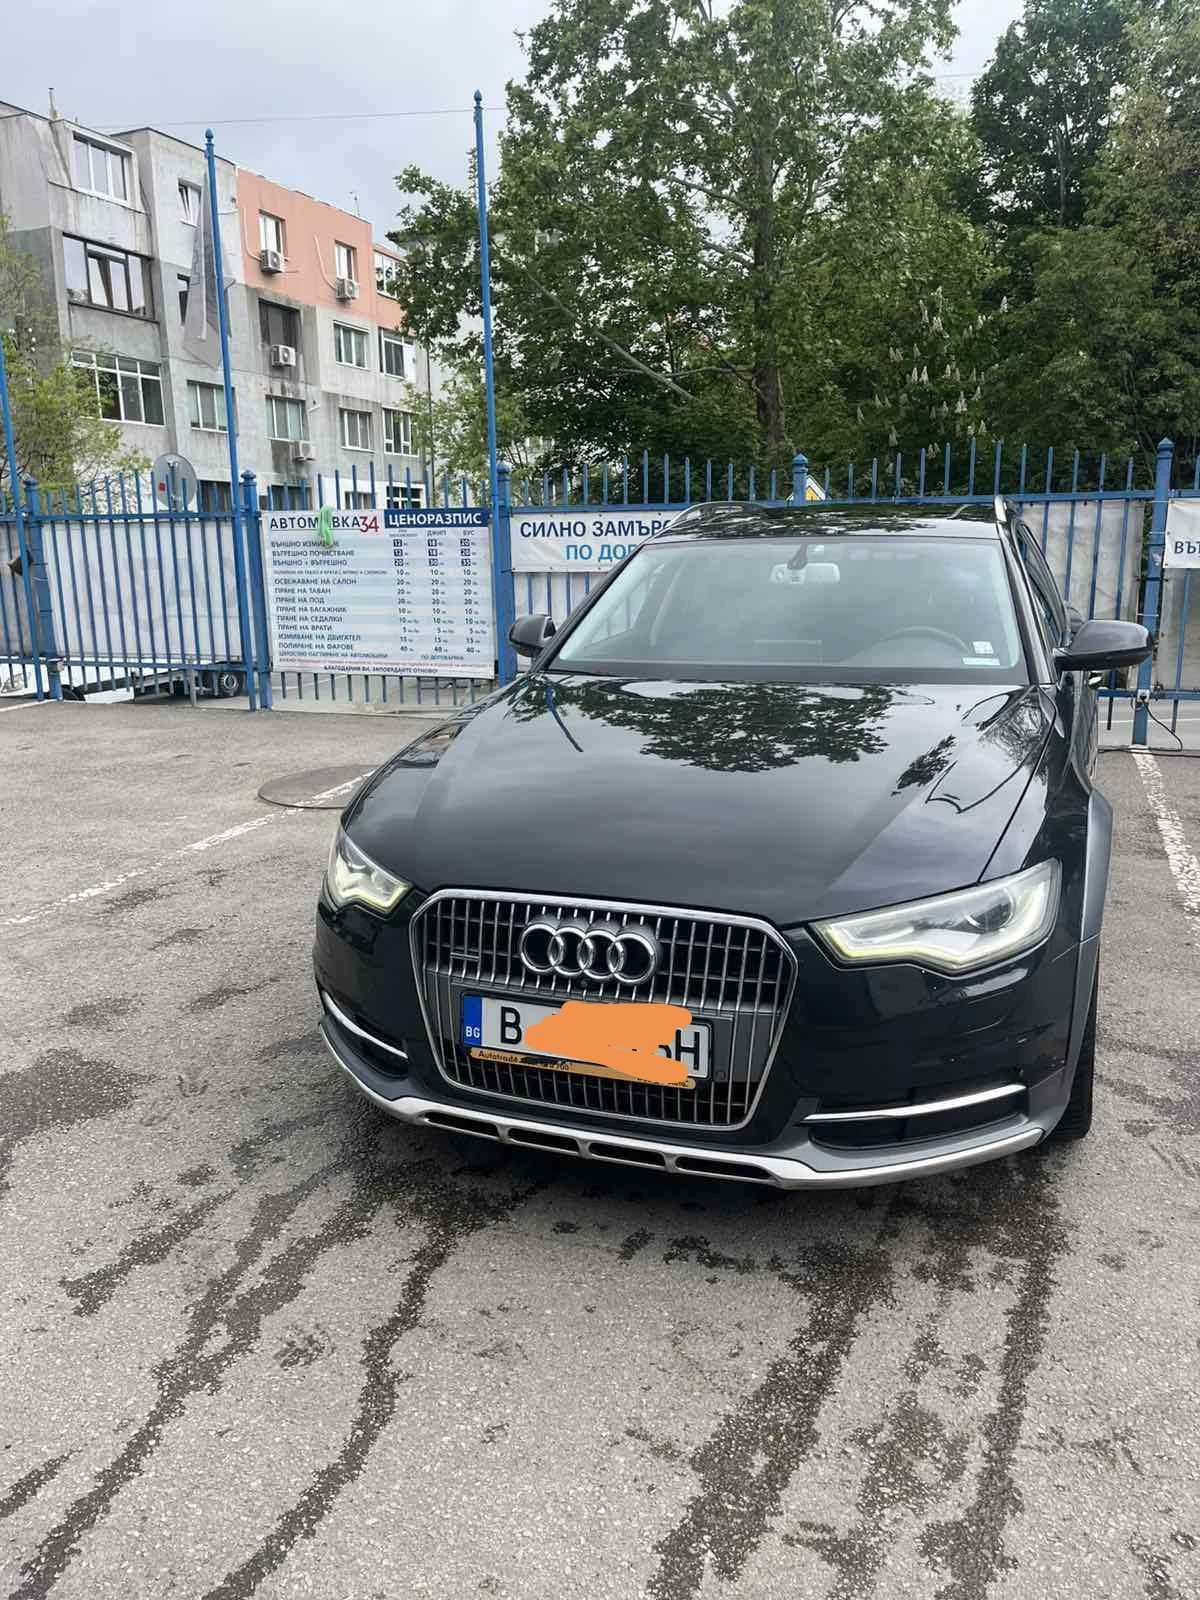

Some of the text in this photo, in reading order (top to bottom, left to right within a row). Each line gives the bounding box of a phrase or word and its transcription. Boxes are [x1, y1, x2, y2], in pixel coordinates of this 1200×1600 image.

[389, 512, 483, 527] ЦЕНОРАЗПИС
[520, 521, 586, 537] СИЛНО
[566, 544, 592, 560] ПО
[465, 1025, 481, 1039] BG
